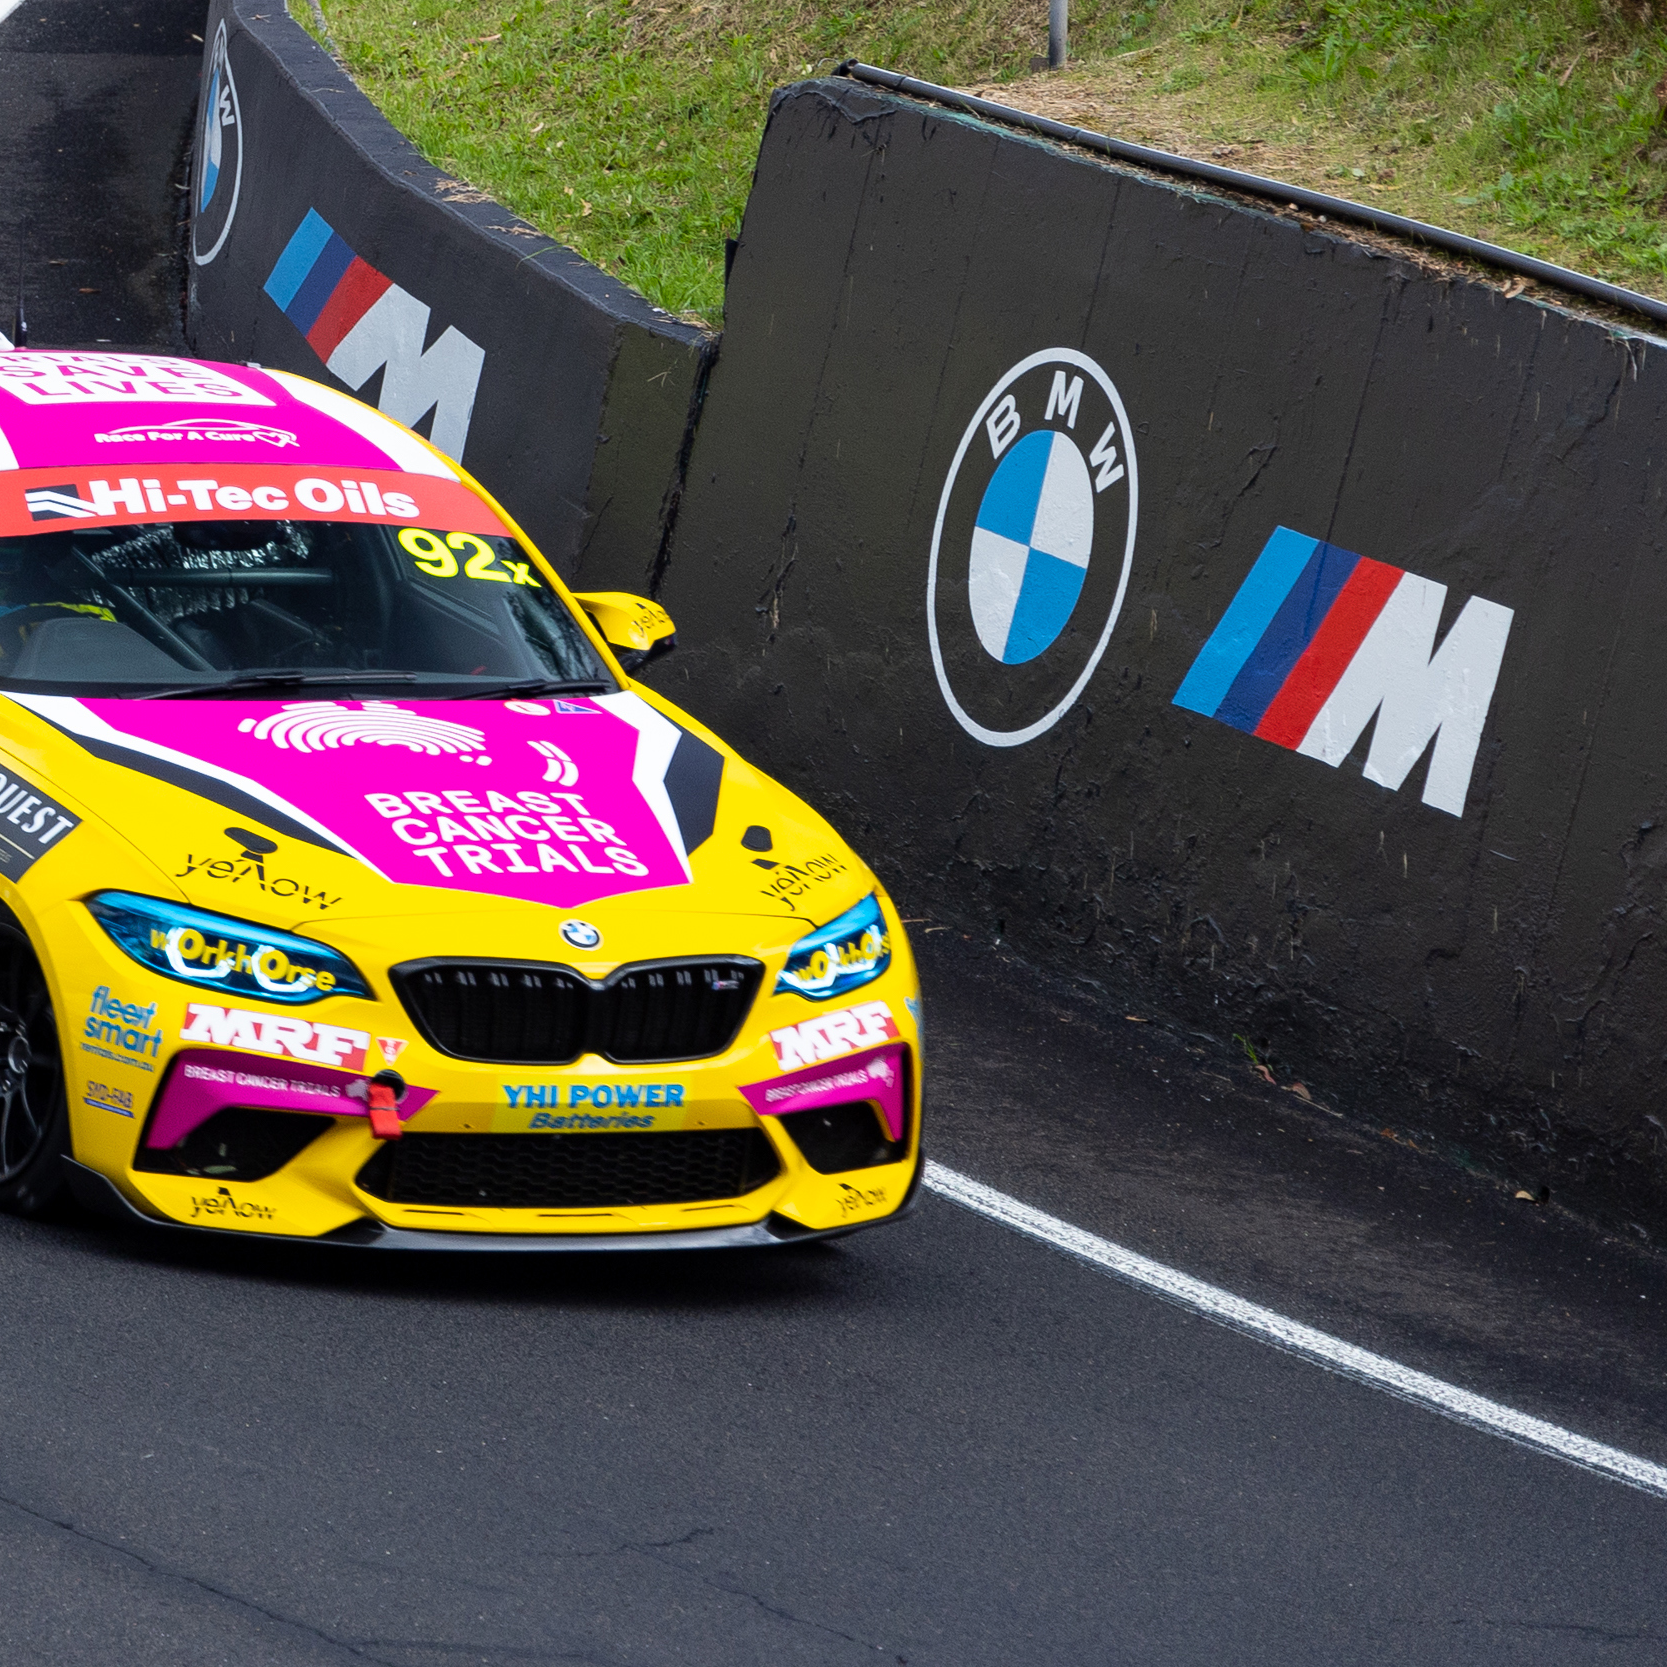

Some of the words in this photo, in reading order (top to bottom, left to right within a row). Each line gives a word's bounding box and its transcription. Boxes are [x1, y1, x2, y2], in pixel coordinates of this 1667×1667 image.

[22, 381, 244, 397] LIVES
[94, 432, 146, 443] Race
[147, 431, 184, 441] For
[187, 431, 204, 441] A
[205, 431, 256, 442] Cure
[986, 370, 1124, 493] BMW
[87, 477, 289, 517] Hi-Tec
[295, 478, 420, 519] Oils
[397, 528, 514, 583] 92
[364, 789, 592, 820] BREAST
[391, 817, 617, 847] CANCER
[415, 844, 650, 878] TRIALS
[84, 1016, 163, 1058] smart
[179, 1003, 369, 1067] MRF
[770, 999, 894, 1072] MRF
[502, 1084, 557, 1109] YHI
[567, 1084, 685, 1108] POWER
[529, 1112, 655, 1130] Batteries
